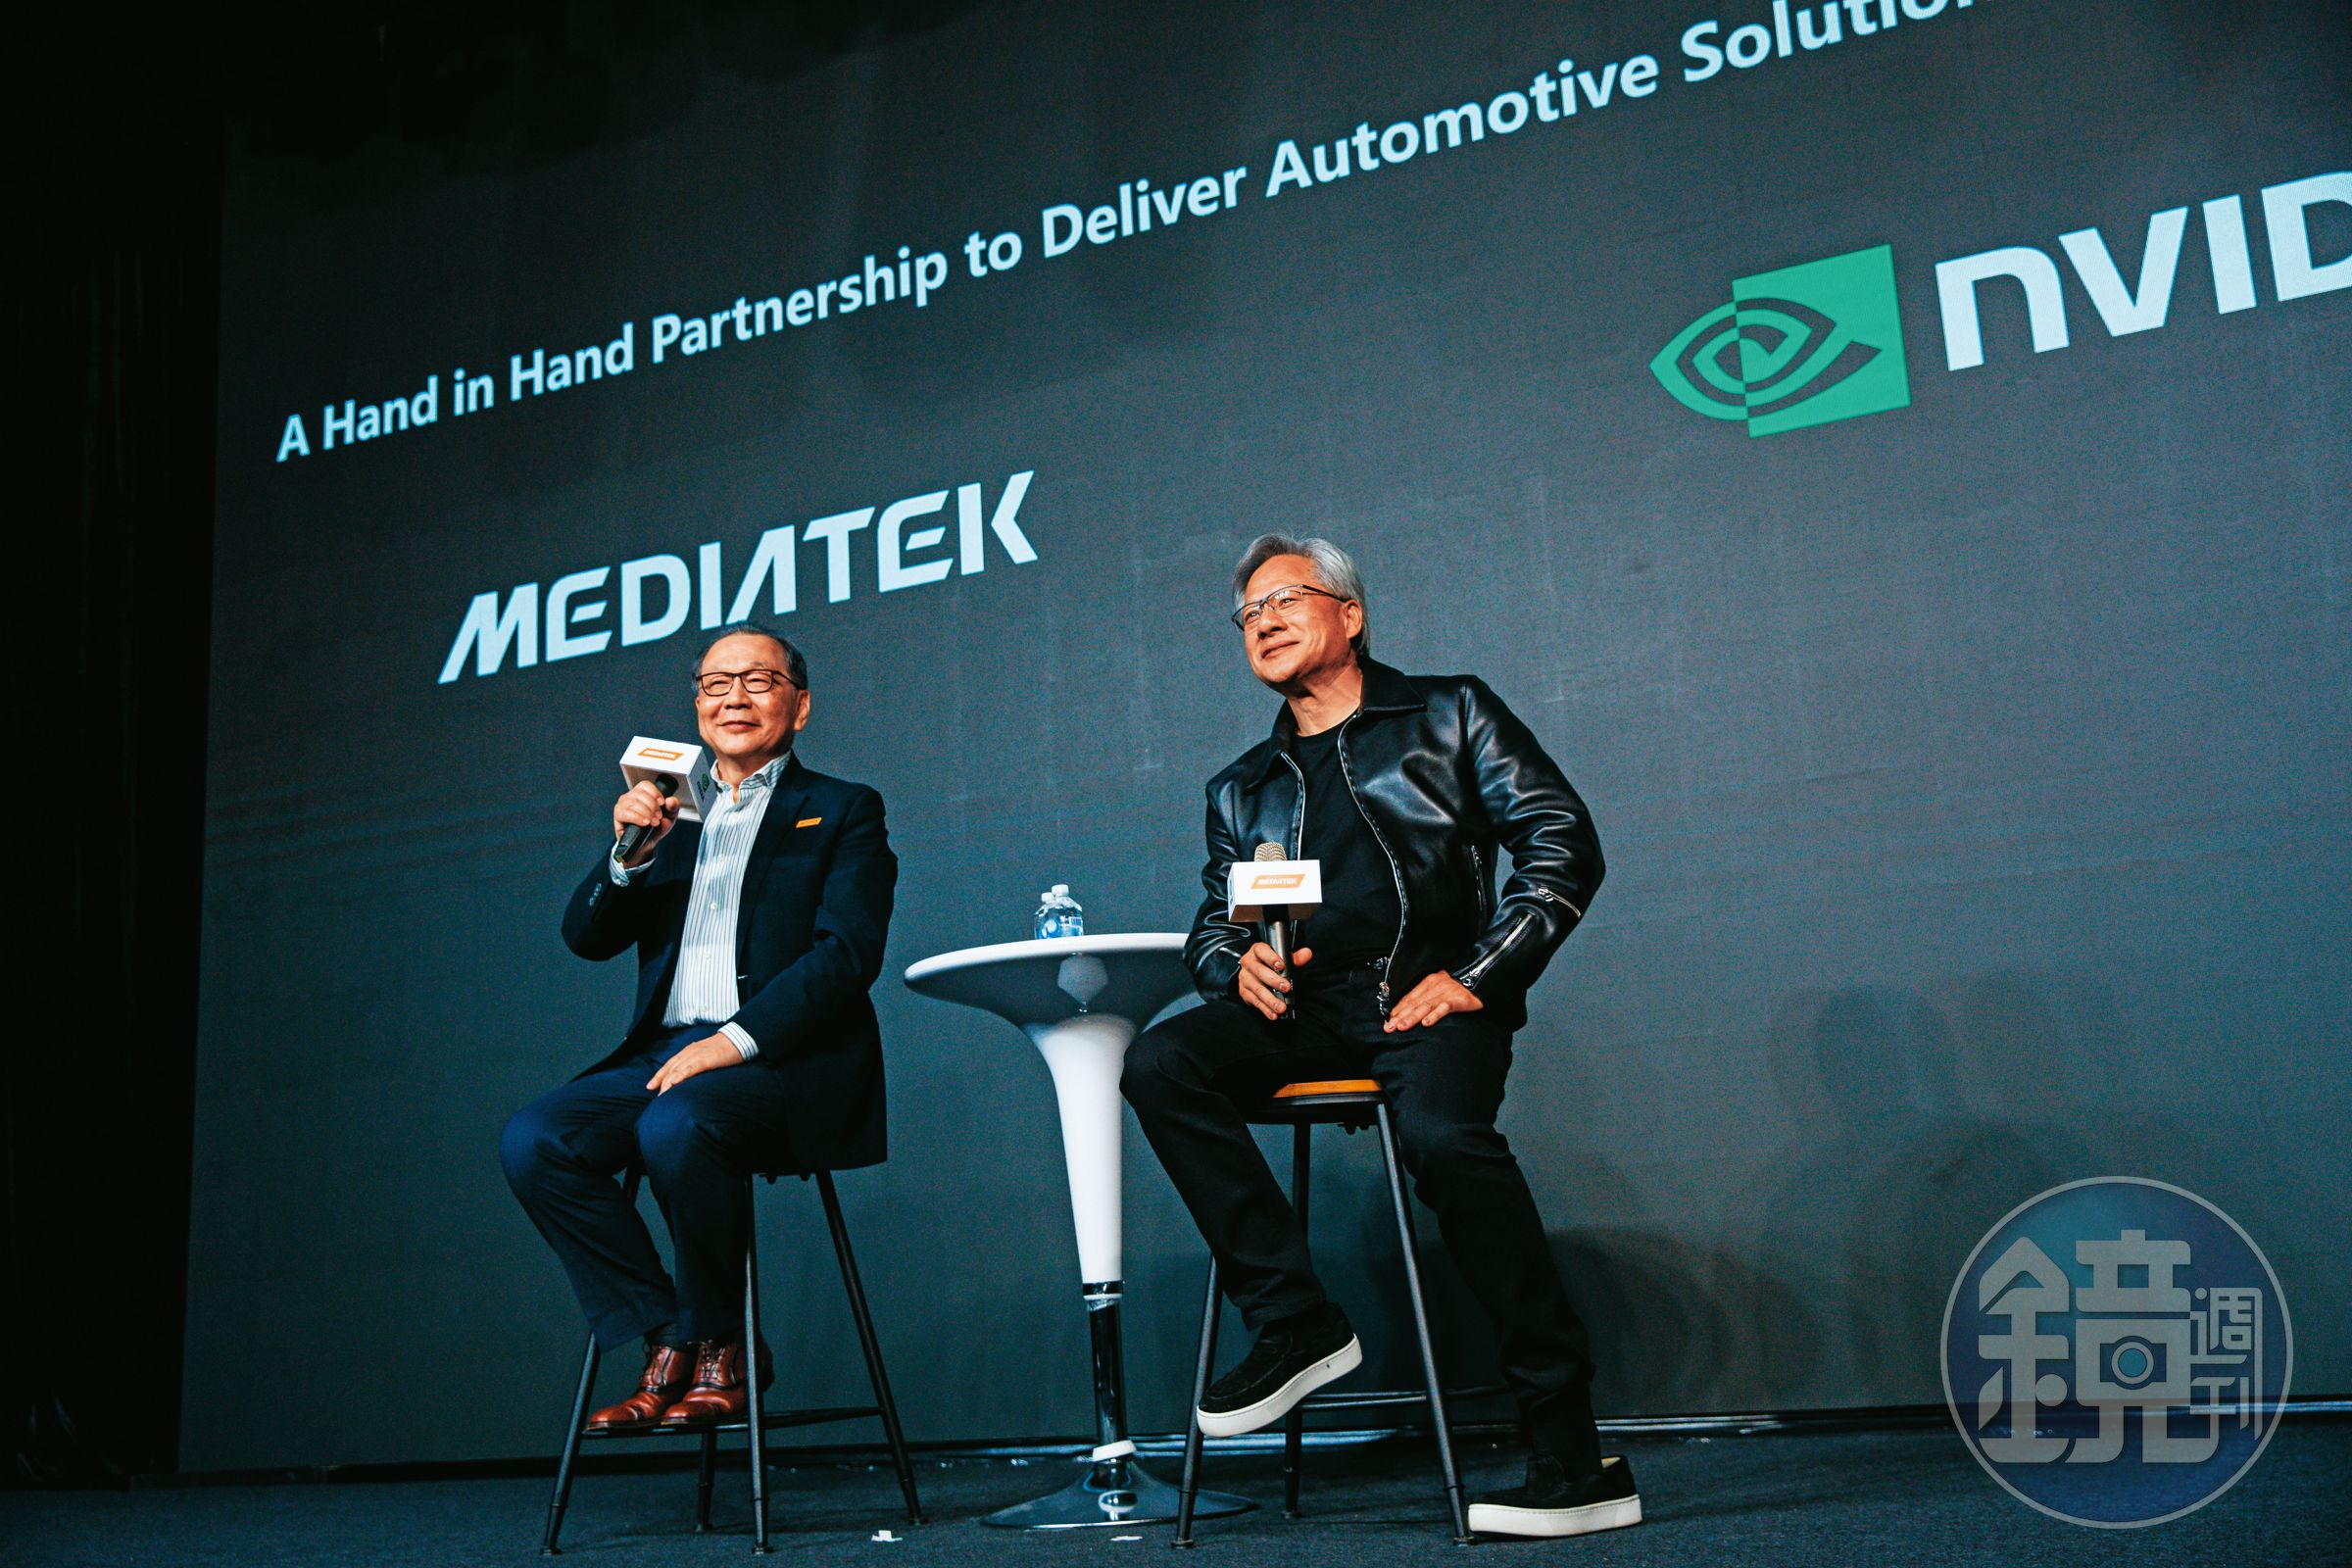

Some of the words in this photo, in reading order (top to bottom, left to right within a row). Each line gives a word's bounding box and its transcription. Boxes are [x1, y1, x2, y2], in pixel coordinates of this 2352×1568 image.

[278, 416, 309, 462] A
[324, 376, 438, 449] Hand
[453, 369, 494, 416] in
[512, 322, 633, 401] Hand
[653, 246, 948, 365] Partnership
[964, 232, 1022, 277] to
[1042, 167, 1247, 258] Deliver
[1265, 55, 1659, 198] Automotive
[438, 469, 1039, 684] MEDIATEK
